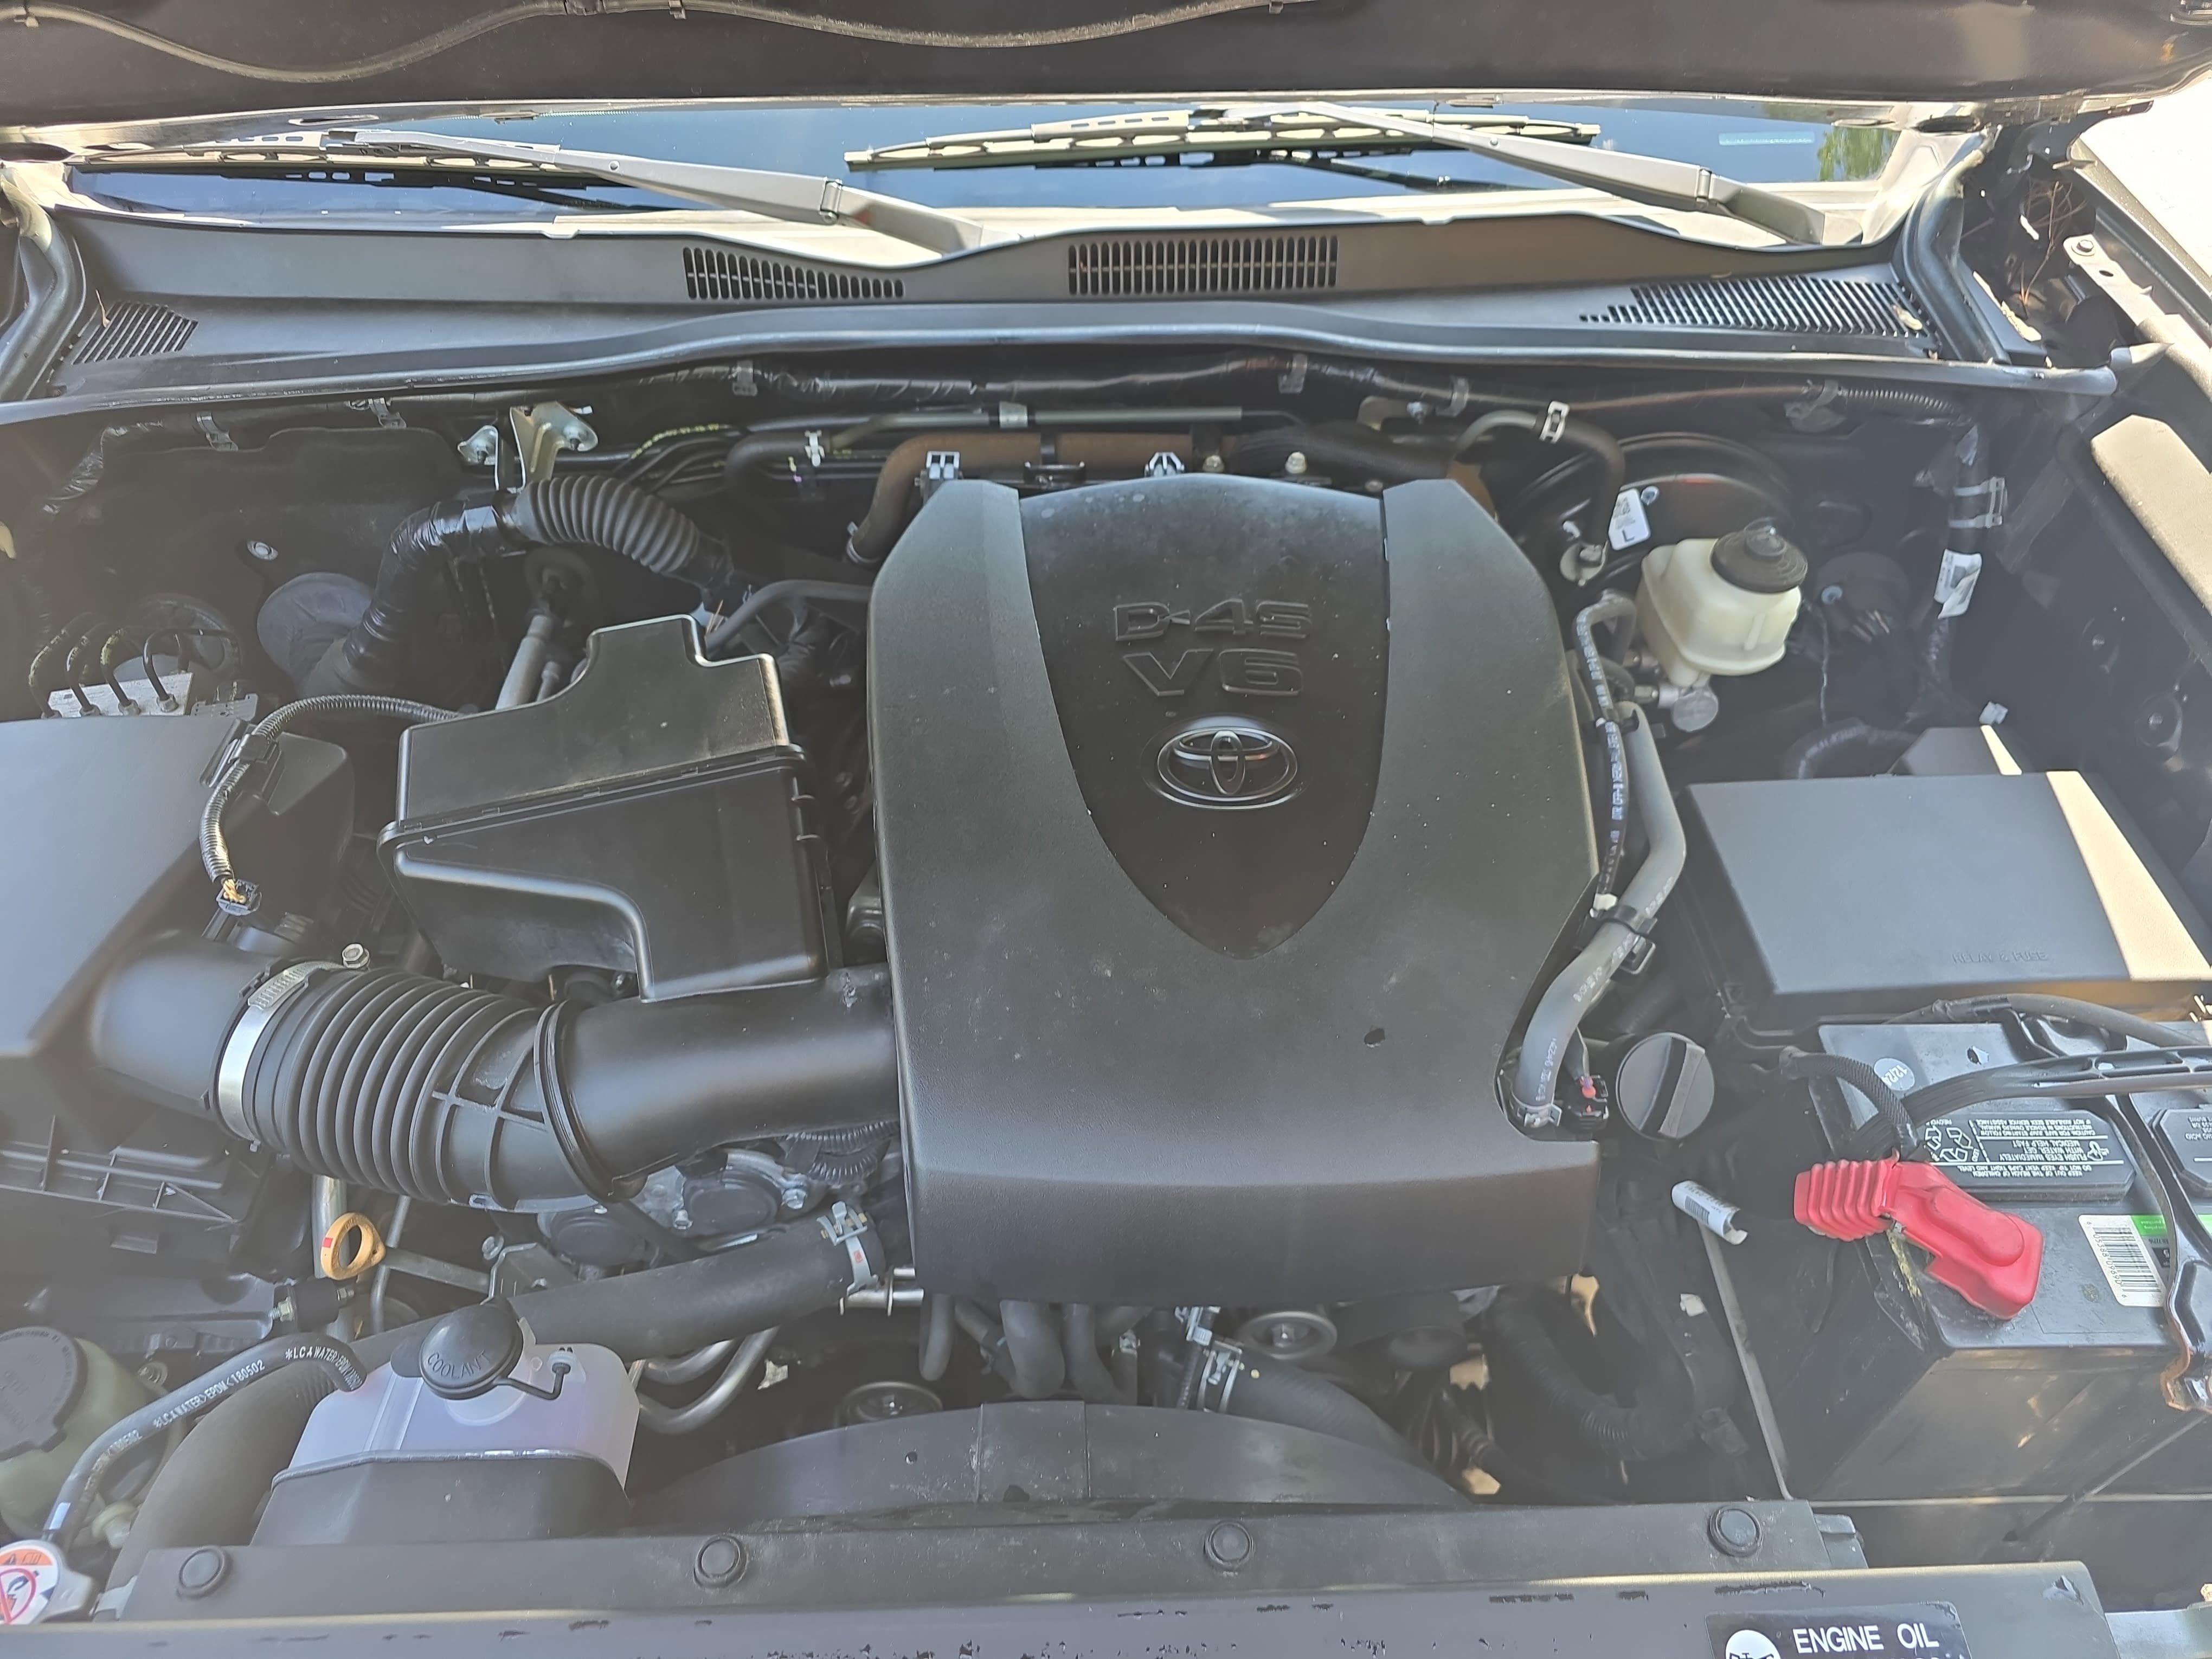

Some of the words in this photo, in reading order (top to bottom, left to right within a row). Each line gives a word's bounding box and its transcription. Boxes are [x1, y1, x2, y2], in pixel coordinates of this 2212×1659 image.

[1114, 598, 1313, 641] D-4S
[1122, 647, 1303, 697] V6
[1952, 952, 1992, 963] RELAY
[2012, 951, 2048, 961] FUSE
[2093, 1234, 2108, 1257] 05388
[2105, 1261, 2122, 1284] 09690
[428, 1350, 491, 1379] COOLANT
[1793, 1624, 1884, 1653] ENGINE
[1897, 1623, 1940, 1648] OIL
